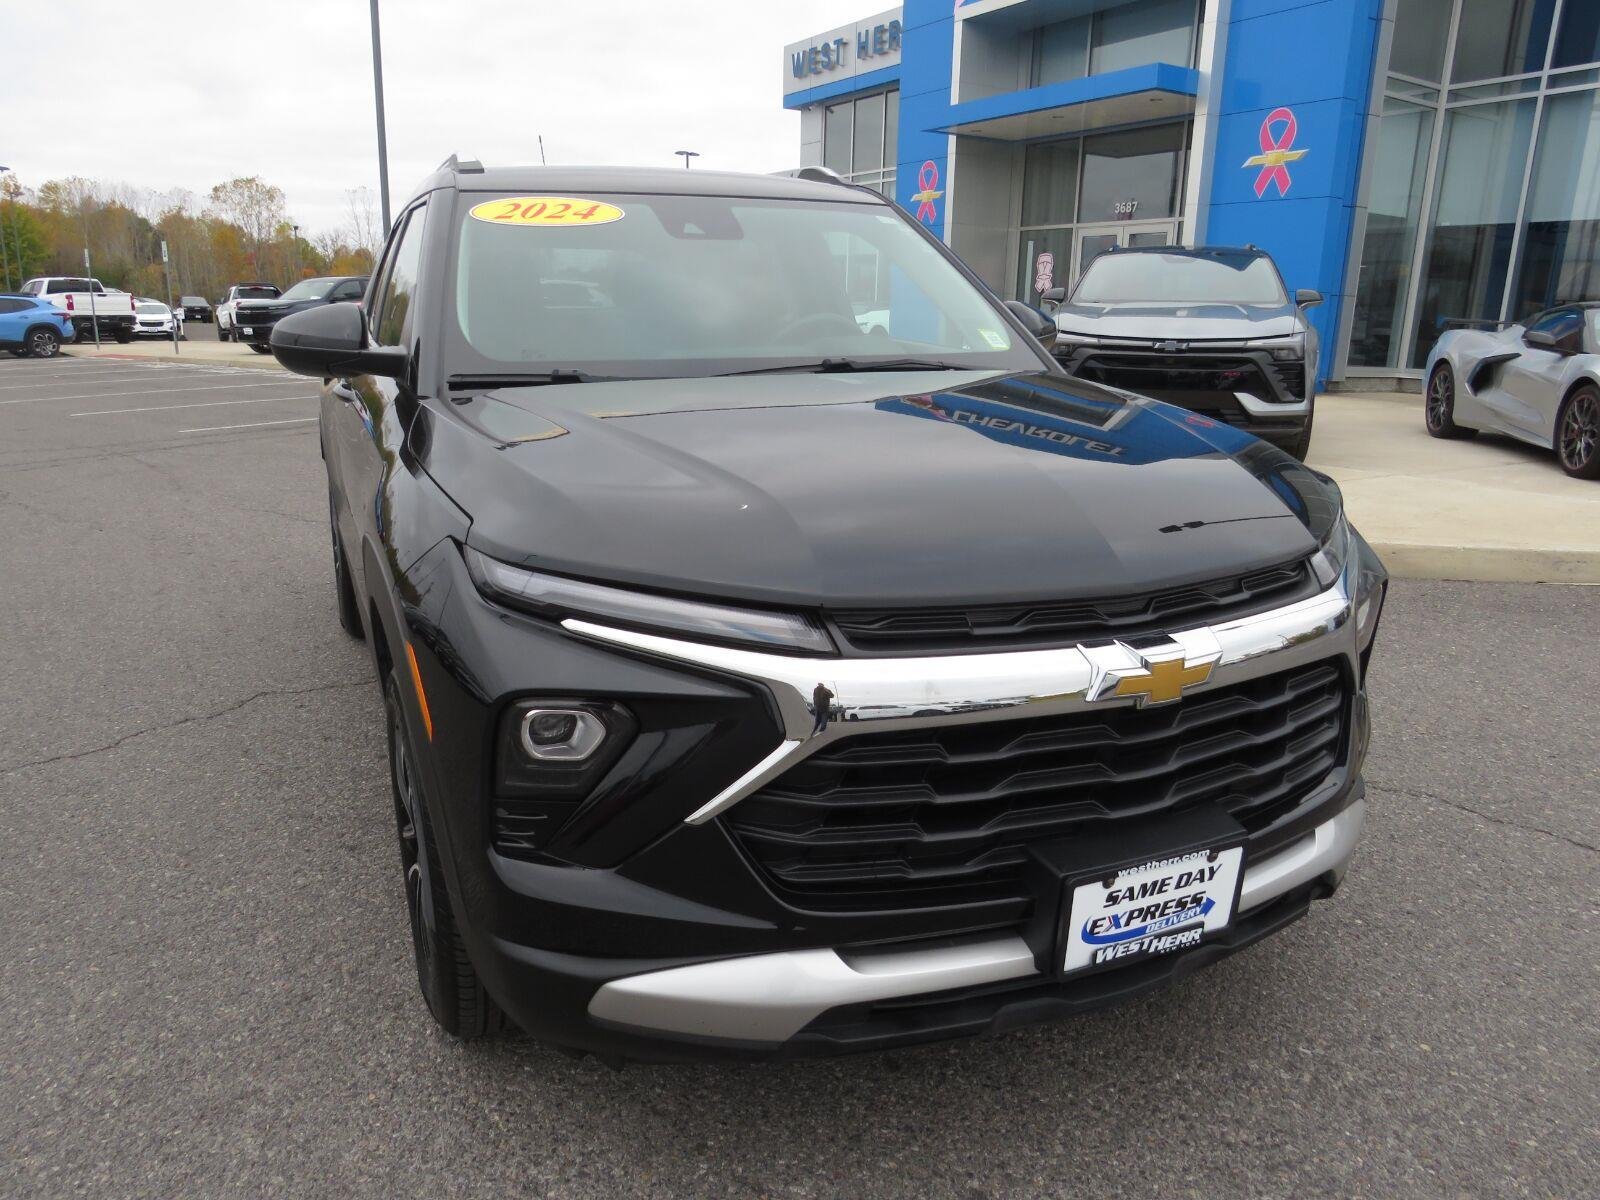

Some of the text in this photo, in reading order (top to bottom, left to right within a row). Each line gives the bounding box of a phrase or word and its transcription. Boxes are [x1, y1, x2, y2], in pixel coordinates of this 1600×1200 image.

[792, 37, 848, 79] WEST
[494, 202, 601, 220] 2024
[1114, 201, 1138, 214] 3687
[1117, 850, 1210, 878] westherr.com
[1103, 863, 1223, 908] SAME DAY
[1088, 891, 1206, 935] EXPRESS
[1145, 905, 1203, 934] DELIVERY
[1095, 928, 1203, 964] WESTHERR
